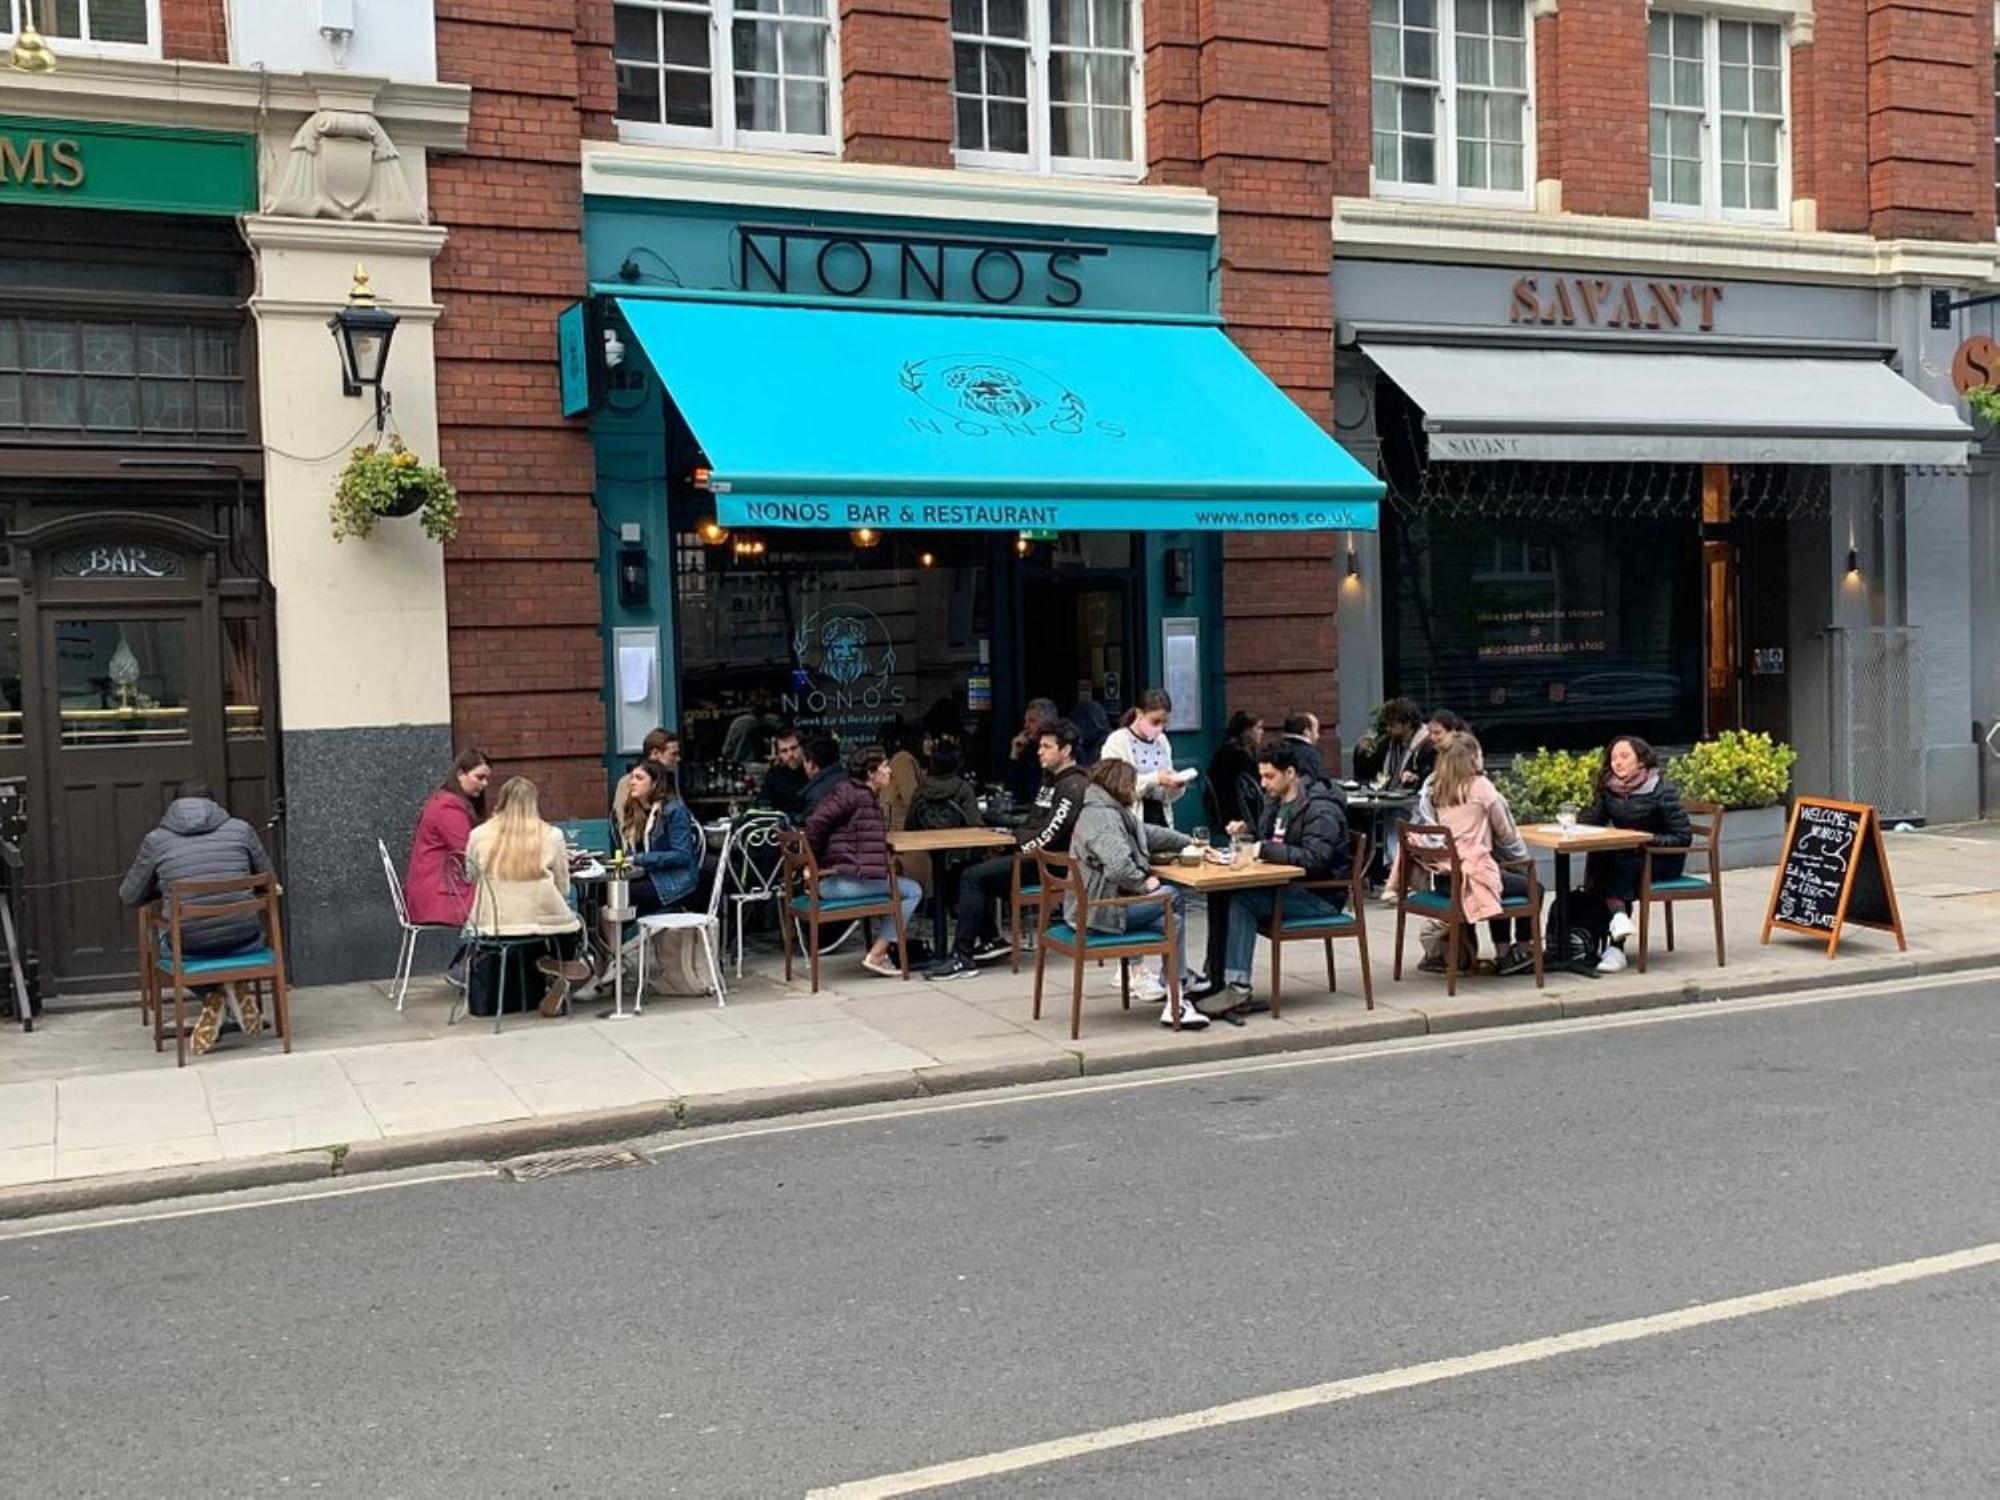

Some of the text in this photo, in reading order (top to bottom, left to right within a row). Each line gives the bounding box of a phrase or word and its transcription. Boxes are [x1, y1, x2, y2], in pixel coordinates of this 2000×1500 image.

[740, 232, 1084, 308] NONOS
[1510, 276, 1725, 332] SAVANT
[907, 416, 1126, 438] NONOS
[1448, 439, 1520, 455] SAVANT
[746, 501, 1060, 525] NONOS BAR & RESTAURANT
[1196, 507, 1353, 526] www.nonos.co.uk
[80, 547, 165, 577] BAR
[781, 686, 905, 713] NONOS
